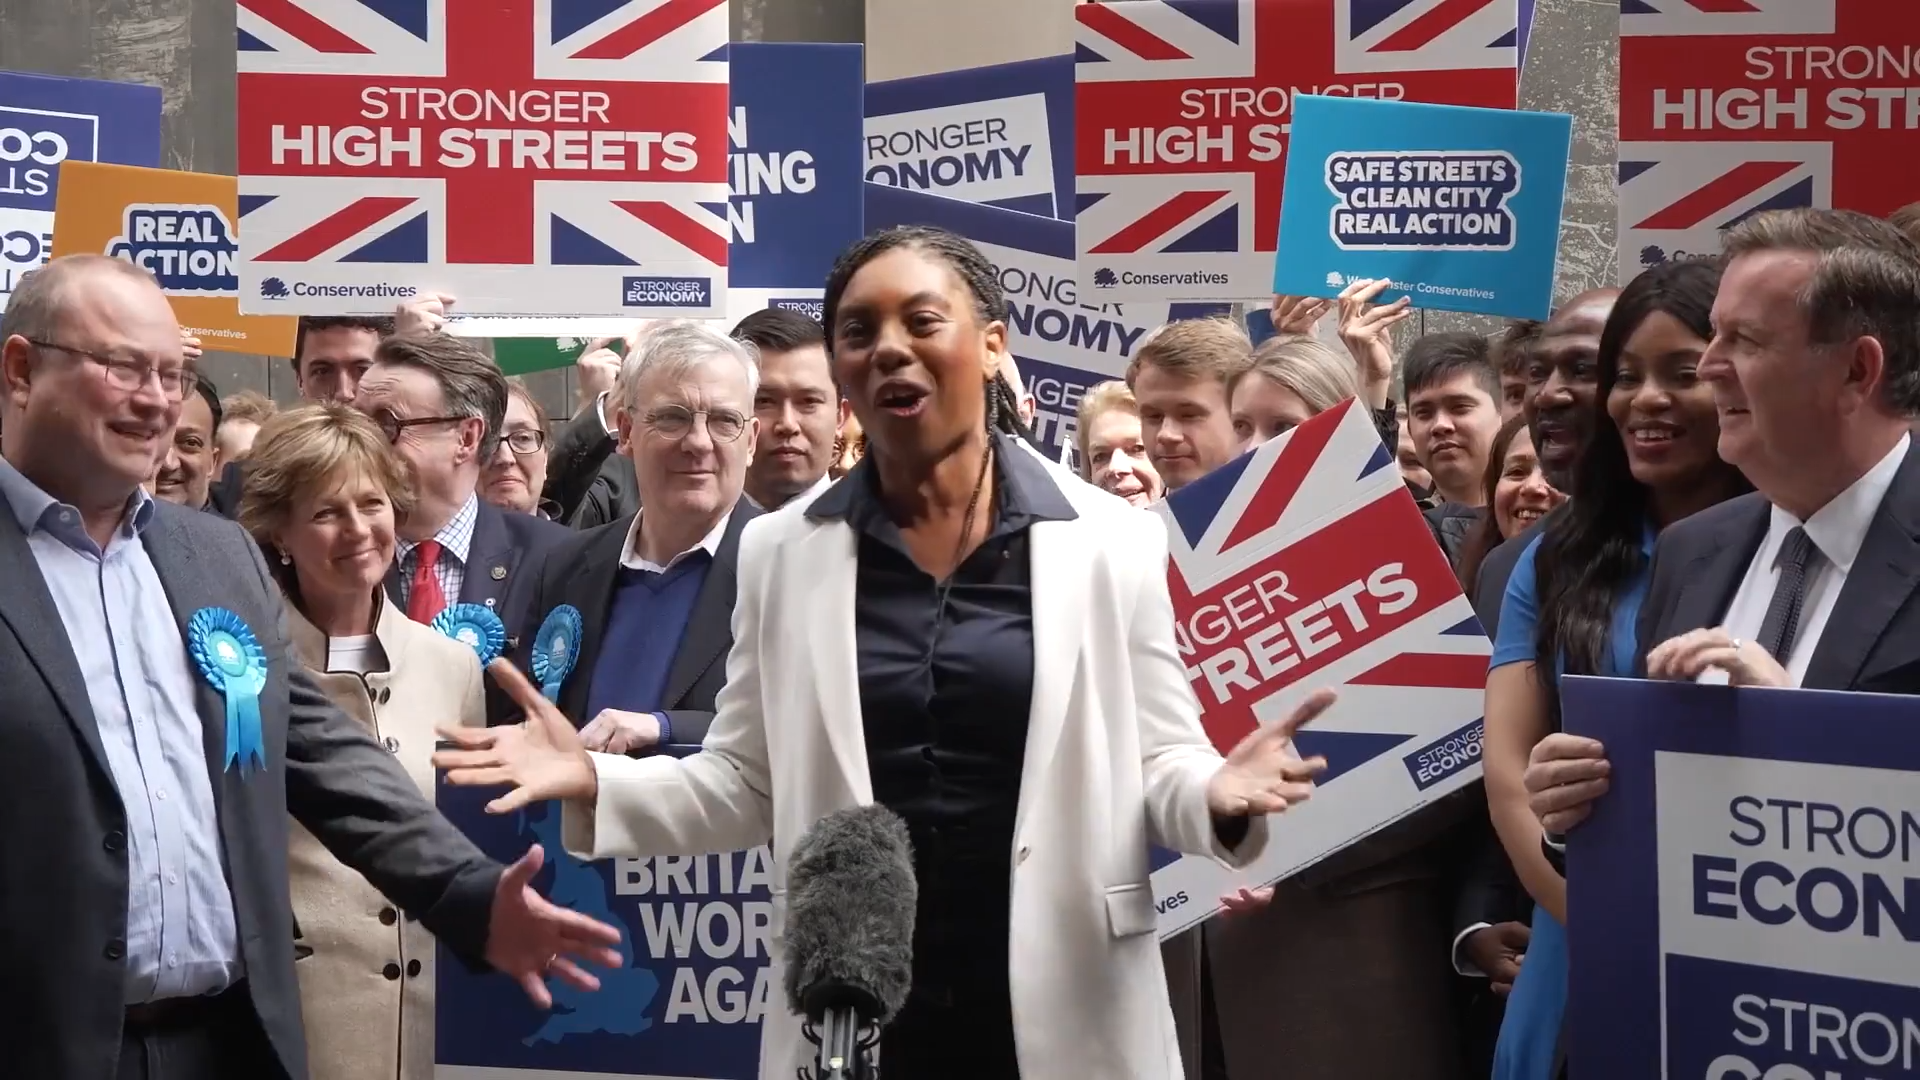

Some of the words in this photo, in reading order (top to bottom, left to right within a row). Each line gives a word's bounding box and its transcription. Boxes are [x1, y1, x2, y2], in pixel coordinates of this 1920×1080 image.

[1745, 45, 1920, 81] STRON
[360, 86, 610, 123] STRONGER
[1653, 88, 1808, 130] HIGH
[272, 124, 421, 167] HIGH
[438, 127, 698, 172] STREETS
[1104, 125, 1233, 165] HIGH
[1334, 161, 1395, 182] SAFE
[1398, 160, 1507, 182] STREETS
[1351, 187, 1430, 208] CLEAN
[1434, 187, 1493, 208] CITY
[135, 216, 219, 243] REAL
[1339, 213, 1400, 235] REAL
[1403, 212, 1502, 235] ACTION
[293, 282, 417, 297] Conservatives
[633, 281, 700, 292] STRONGER
[1122, 270, 1229, 285] Conservatives
[1416, 282, 1495, 300] Conservatives
[626, 290, 706, 302] ECONOMY
[1417, 738, 1484, 783] ECONO
[1693, 853, 1920, 942] ECON
[638, 901, 773, 959] WOR
